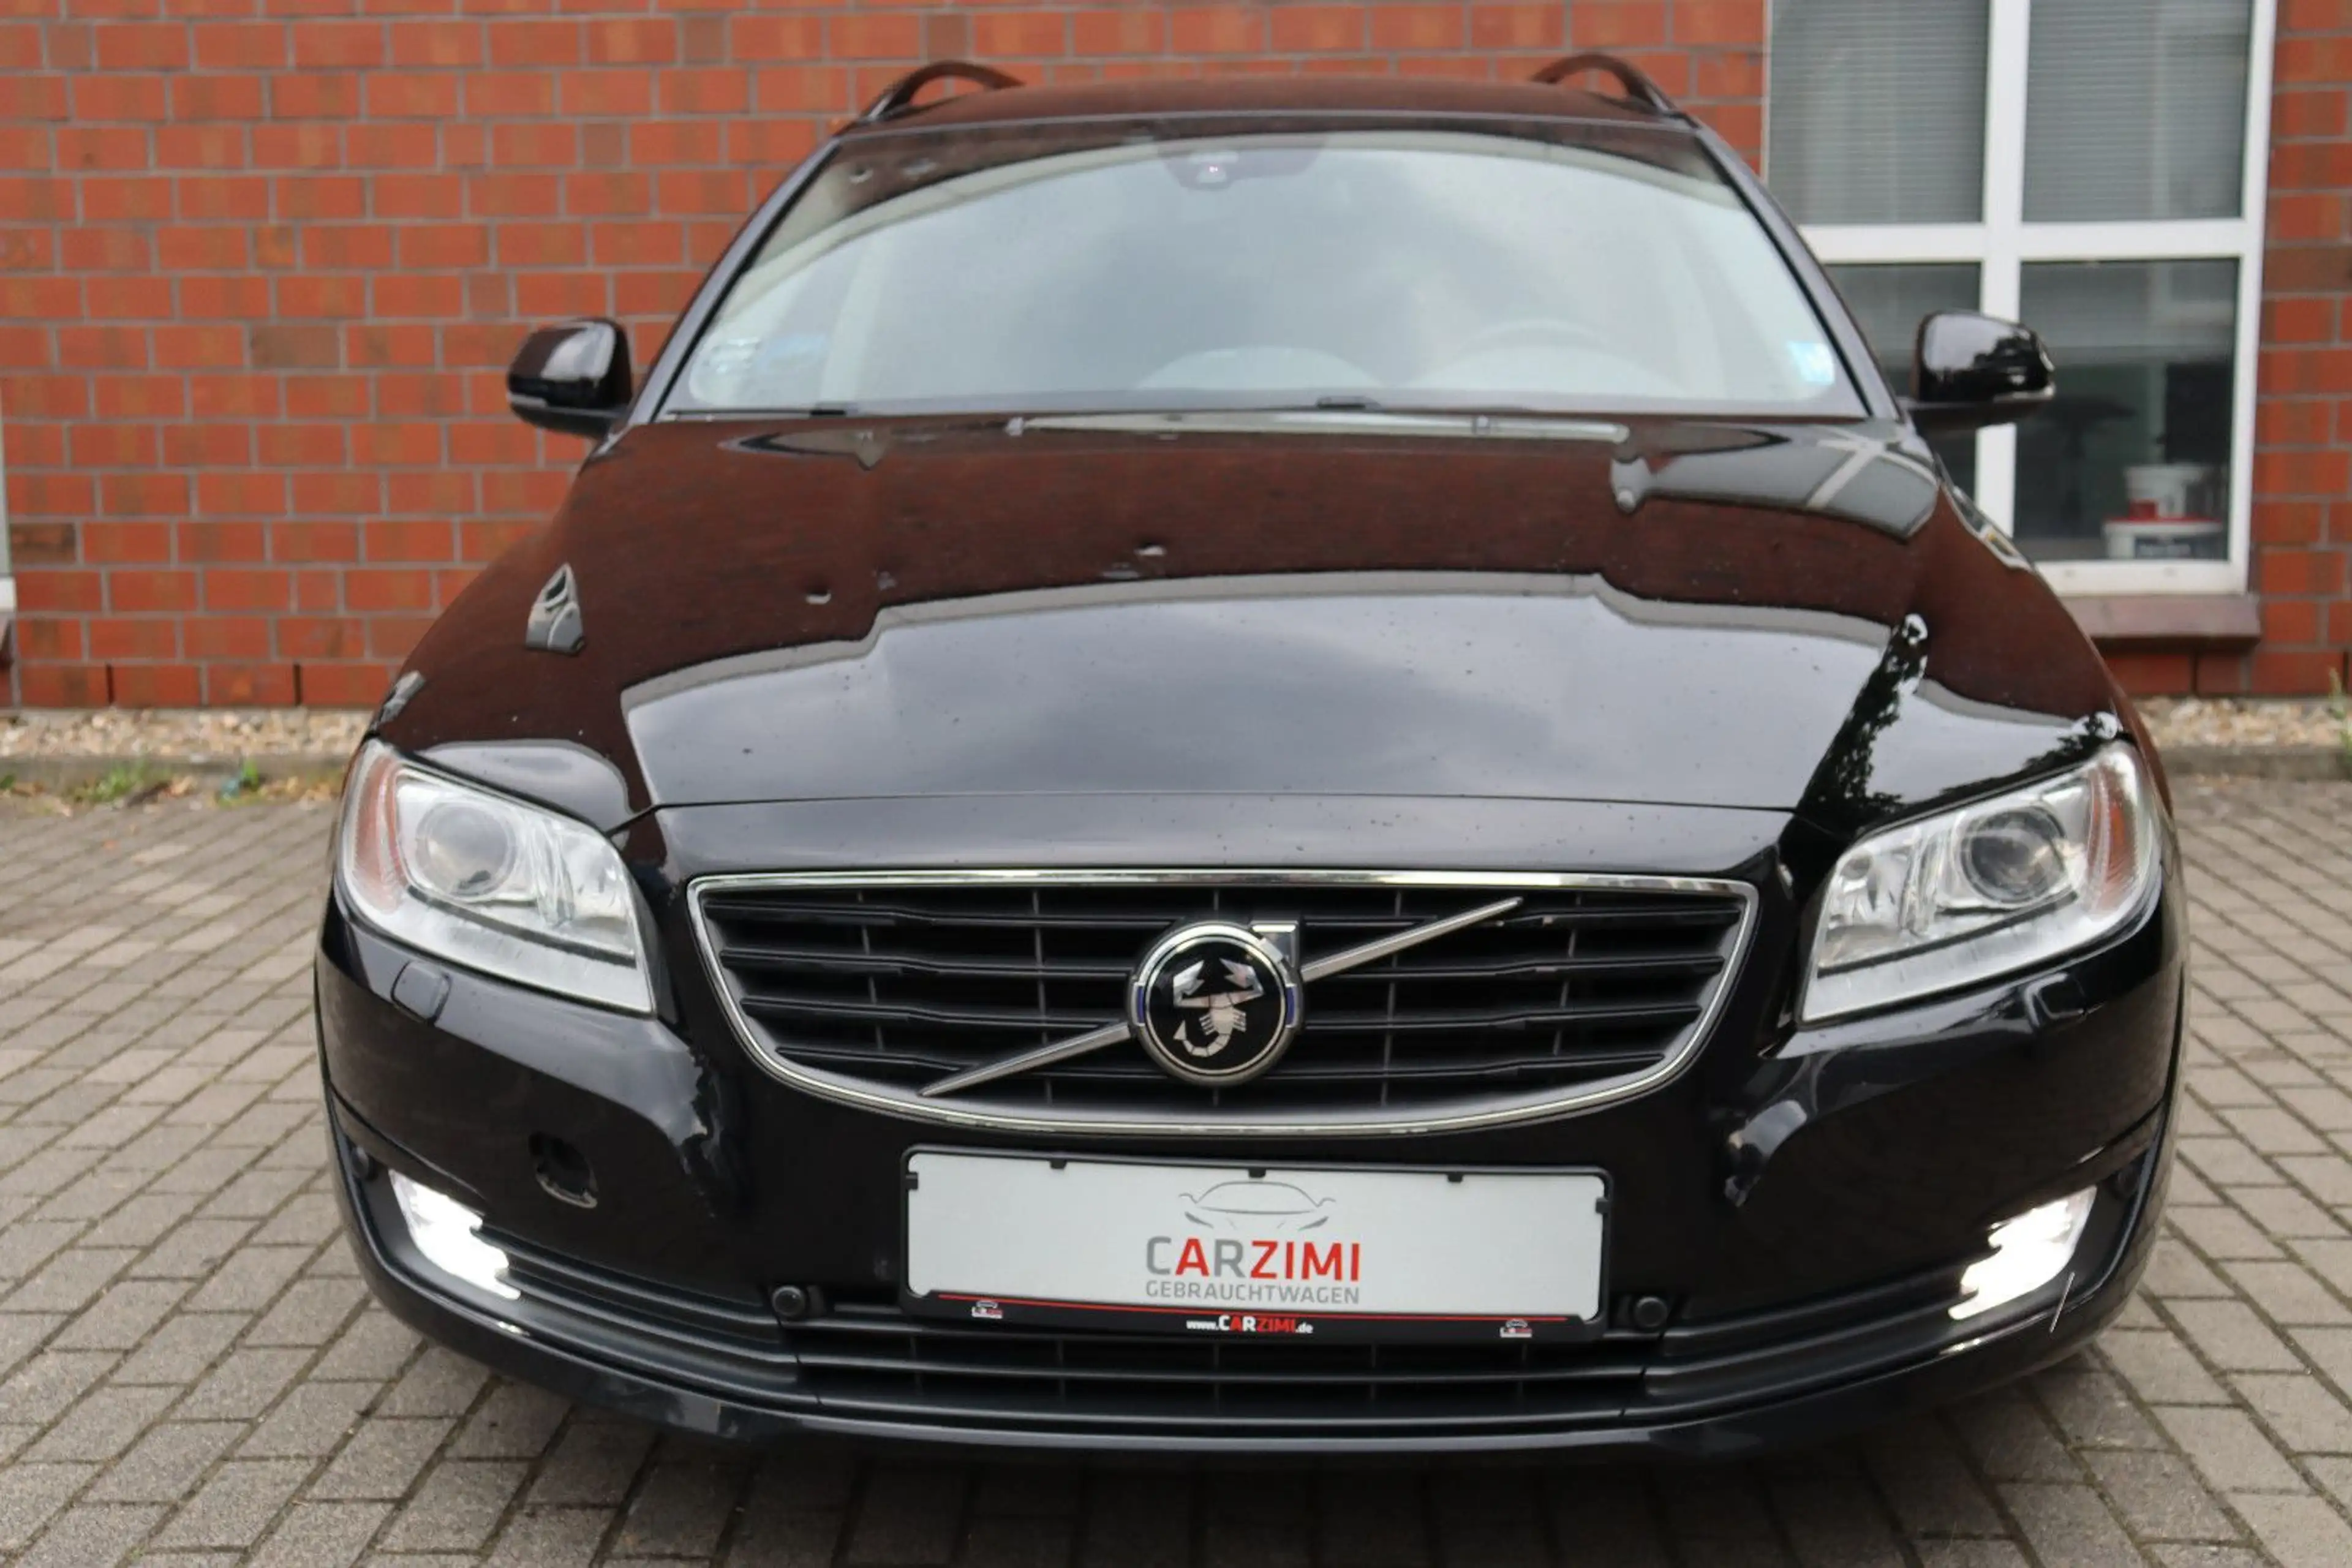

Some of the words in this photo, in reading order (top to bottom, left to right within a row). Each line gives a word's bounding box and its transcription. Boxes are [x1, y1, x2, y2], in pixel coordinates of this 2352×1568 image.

[1146, 1236, 1360, 1281] CARZIMI
[1146, 1280, 1360, 1304] GEBRAUCHTWAGEN
[1186, 1315, 1313, 1334] www.CARZIMI.de
